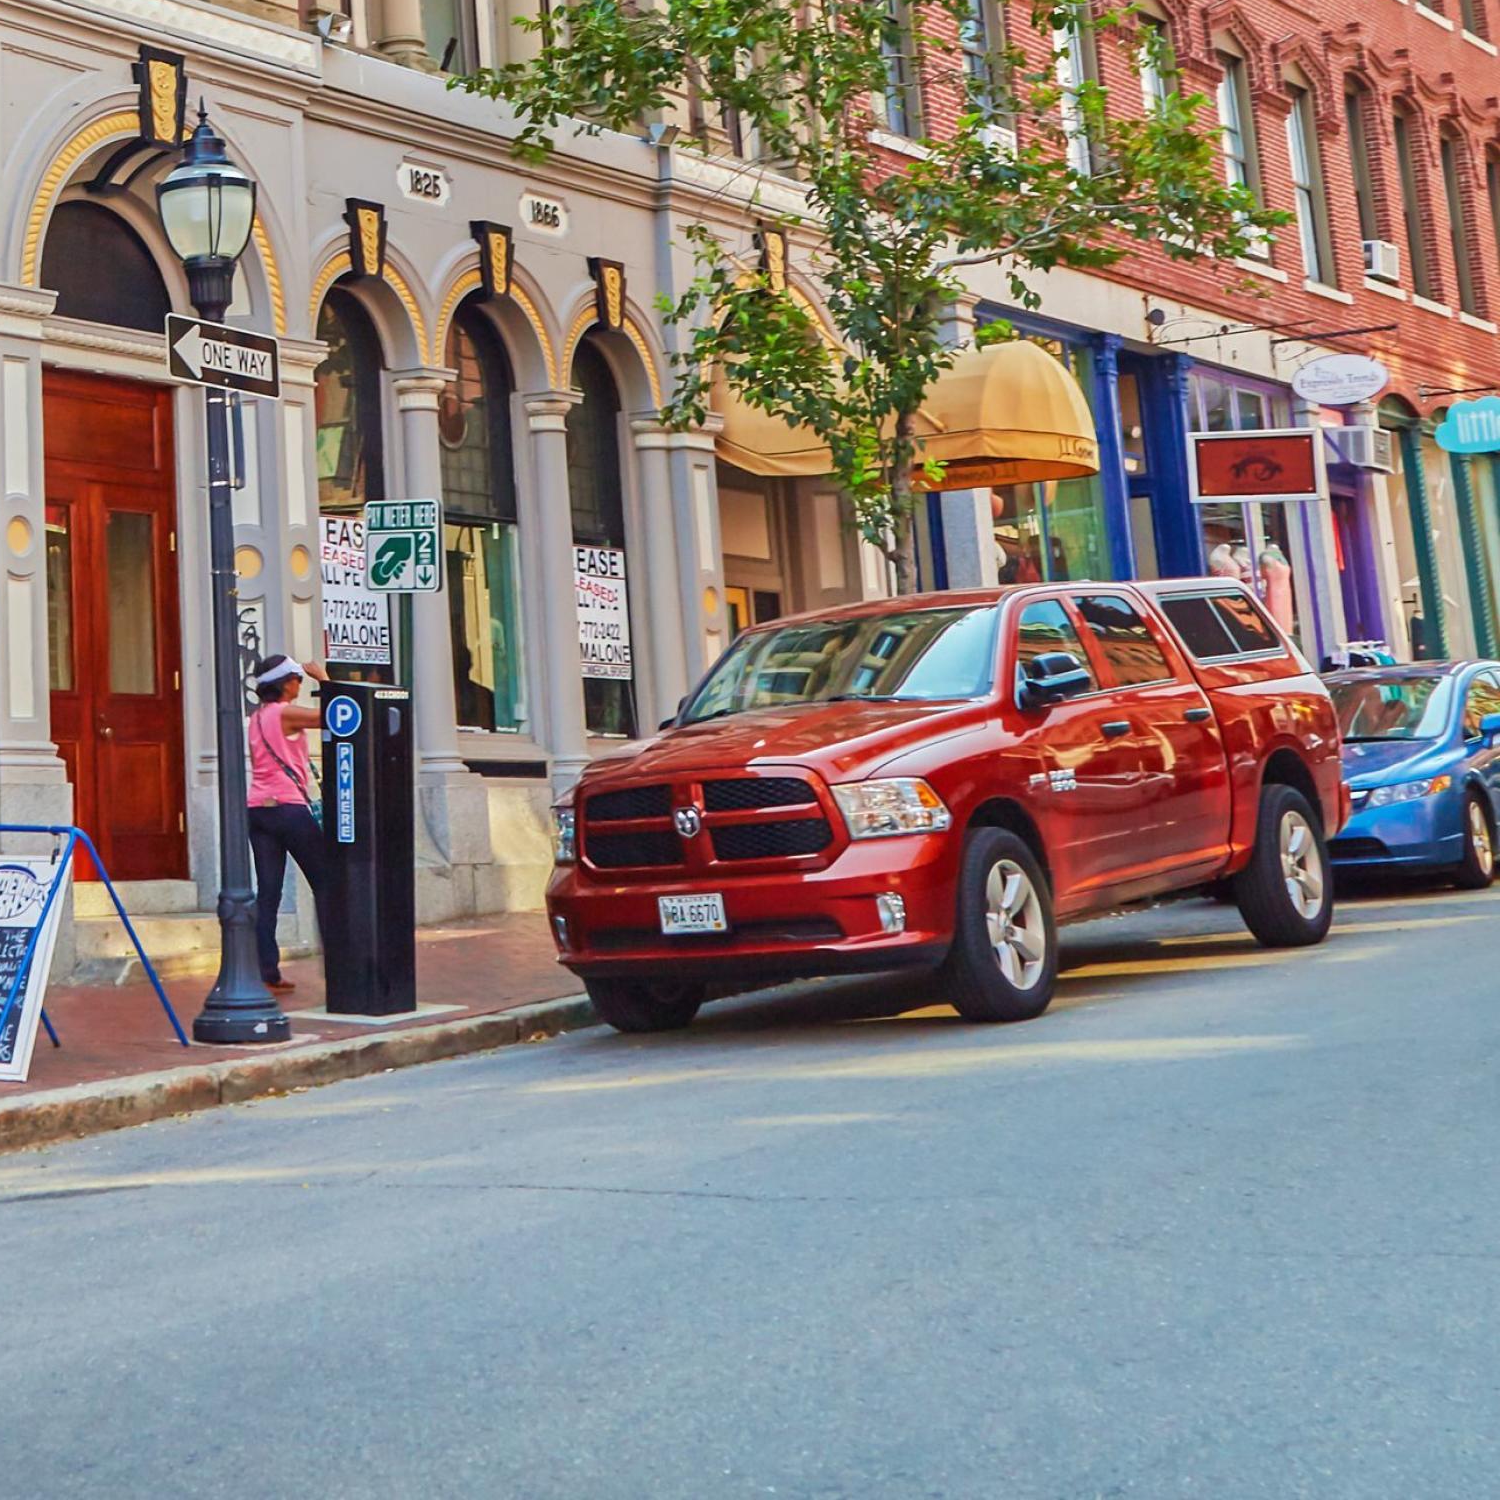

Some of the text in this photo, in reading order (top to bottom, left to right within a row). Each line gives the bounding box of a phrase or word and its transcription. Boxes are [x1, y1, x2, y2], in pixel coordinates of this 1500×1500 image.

[409, 169, 442, 198] 1825
[530, 200, 560, 229] 1866
[203, 342, 267, 376] ONE WAY
[367, 506, 382, 528] PAY
[383, 505, 411, 527] METER
[326, 519, 364, 549] EAS
[418, 532, 432, 552] 2
[322, 546, 365, 571] EASED
[577, 548, 619, 576] EASE
[323, 599, 377, 621] 7-772-2422
[328, 622, 389, 646] MALONE
[579, 621, 620, 640] -772-2422
[580, 642, 630, 663] MALONE
[336, 704, 352, 728] P
[340, 747, 351, 838] PAY HERE
[3, 929, 29, 944] THE
